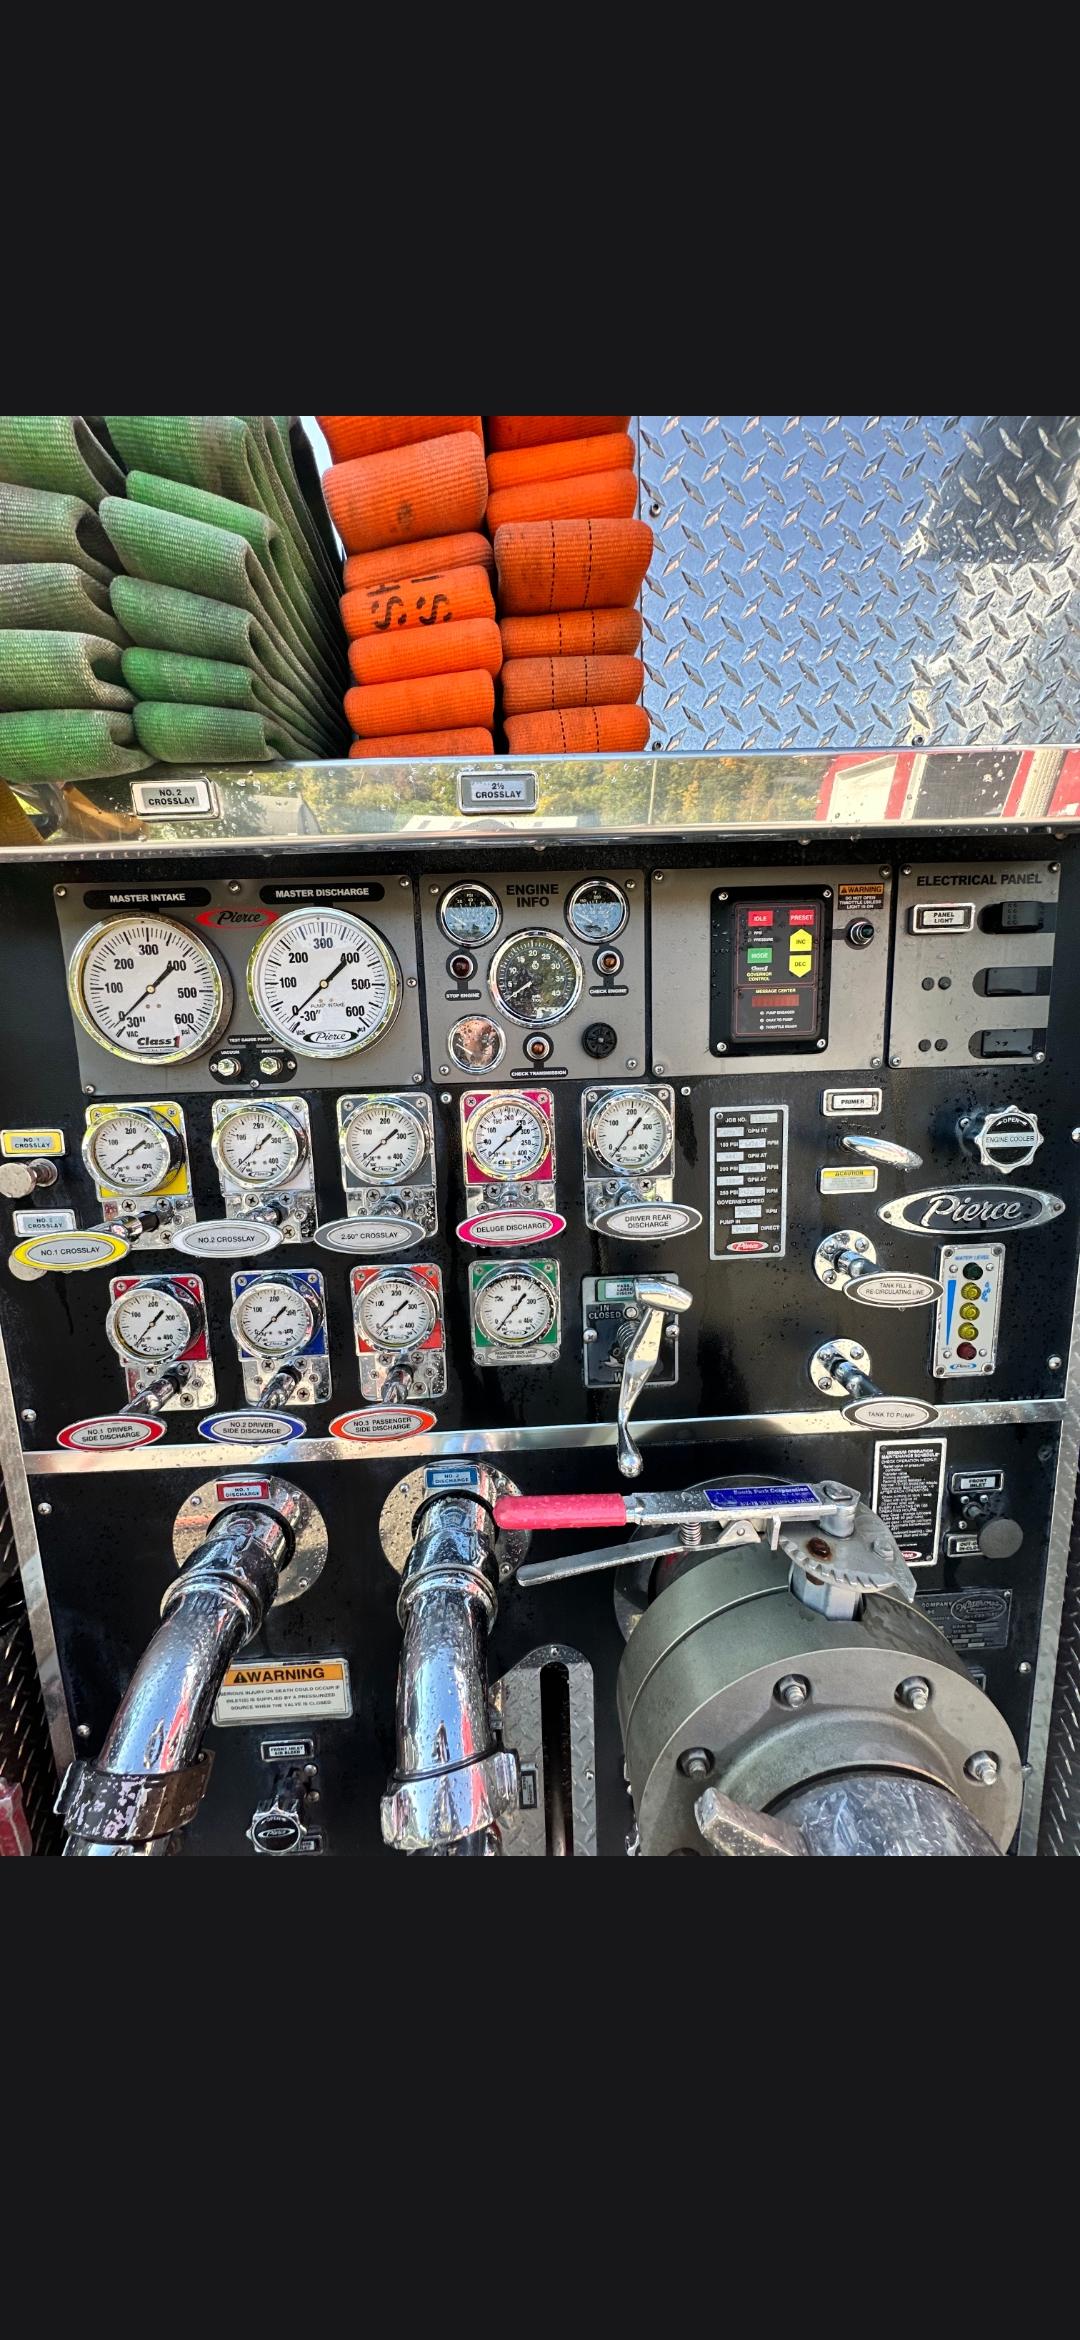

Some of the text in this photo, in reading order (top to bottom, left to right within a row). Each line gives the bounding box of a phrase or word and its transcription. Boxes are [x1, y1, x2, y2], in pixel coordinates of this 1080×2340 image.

[160, 789, 175, 797] NO.
[475, 790, 521, 799] CROSSLAY
[149, 797, 195, 806] CROSSLAY
[917, 873, 1042, 887] ELECTRICAL PANEL
[275, 887, 369, 898] MASTER DISCHARGE
[506, 884, 559, 896] ENGINE
[848, 885, 882, 893] WARNING
[109, 893, 186, 904] MASTER INTAKE
[516, 896, 550, 908] INFO
[216, 910, 261, 925] Pierce
[313, 937, 334, 949] 300
[138, 944, 159, 956] 300
[528, 949, 538, 957] 20
[288, 952, 309, 963] 200
[340, 952, 360, 963] 400
[114, 958, 134, 970] 200
[166, 960, 187, 971] 400
[104, 982, 123, 993] 100
[279, 977, 297, 988] 100
[351, 978, 371, 990] 500
[177, 987, 197, 999] 500
[118, 1010, 125, 1022] 0
[292, 1005, 299, 1016] 0
[345, 1005, 365, 1017] 600
[174, 1012, 194, 1024] 600
[126, 1030, 139, 1038] VAC
[181, 1028, 190, 1036] psi
[315, 1032, 346, 1042] Pierce
[137, 1036, 180, 1048] Class1
[920, 1194, 1022, 1228] Pierce
[624, 1215, 650, 1223] DRIVER
[476, 1222, 547, 1234] DELUGE DISCHARGE
[628, 1221, 669, 1229] DISCHARGE
[216, 1235, 255, 1243] CROSSLAY
[60, 1247, 100, 1255] CROSSLAY
[600, 1304, 610, 1312] IN
[588, 1310, 621, 1320] CLOSED
[230, 1421, 246, 1429] NO.2
[372, 1416, 412, 1425] PASSENGER
[107, 1425, 133, 1434] DRIVER
[372, 1424, 411, 1432] DISCHARGE
[81, 1431, 141, 1442] SIDE DISCHARGE
[246, 1667, 325, 1682] WARNING
